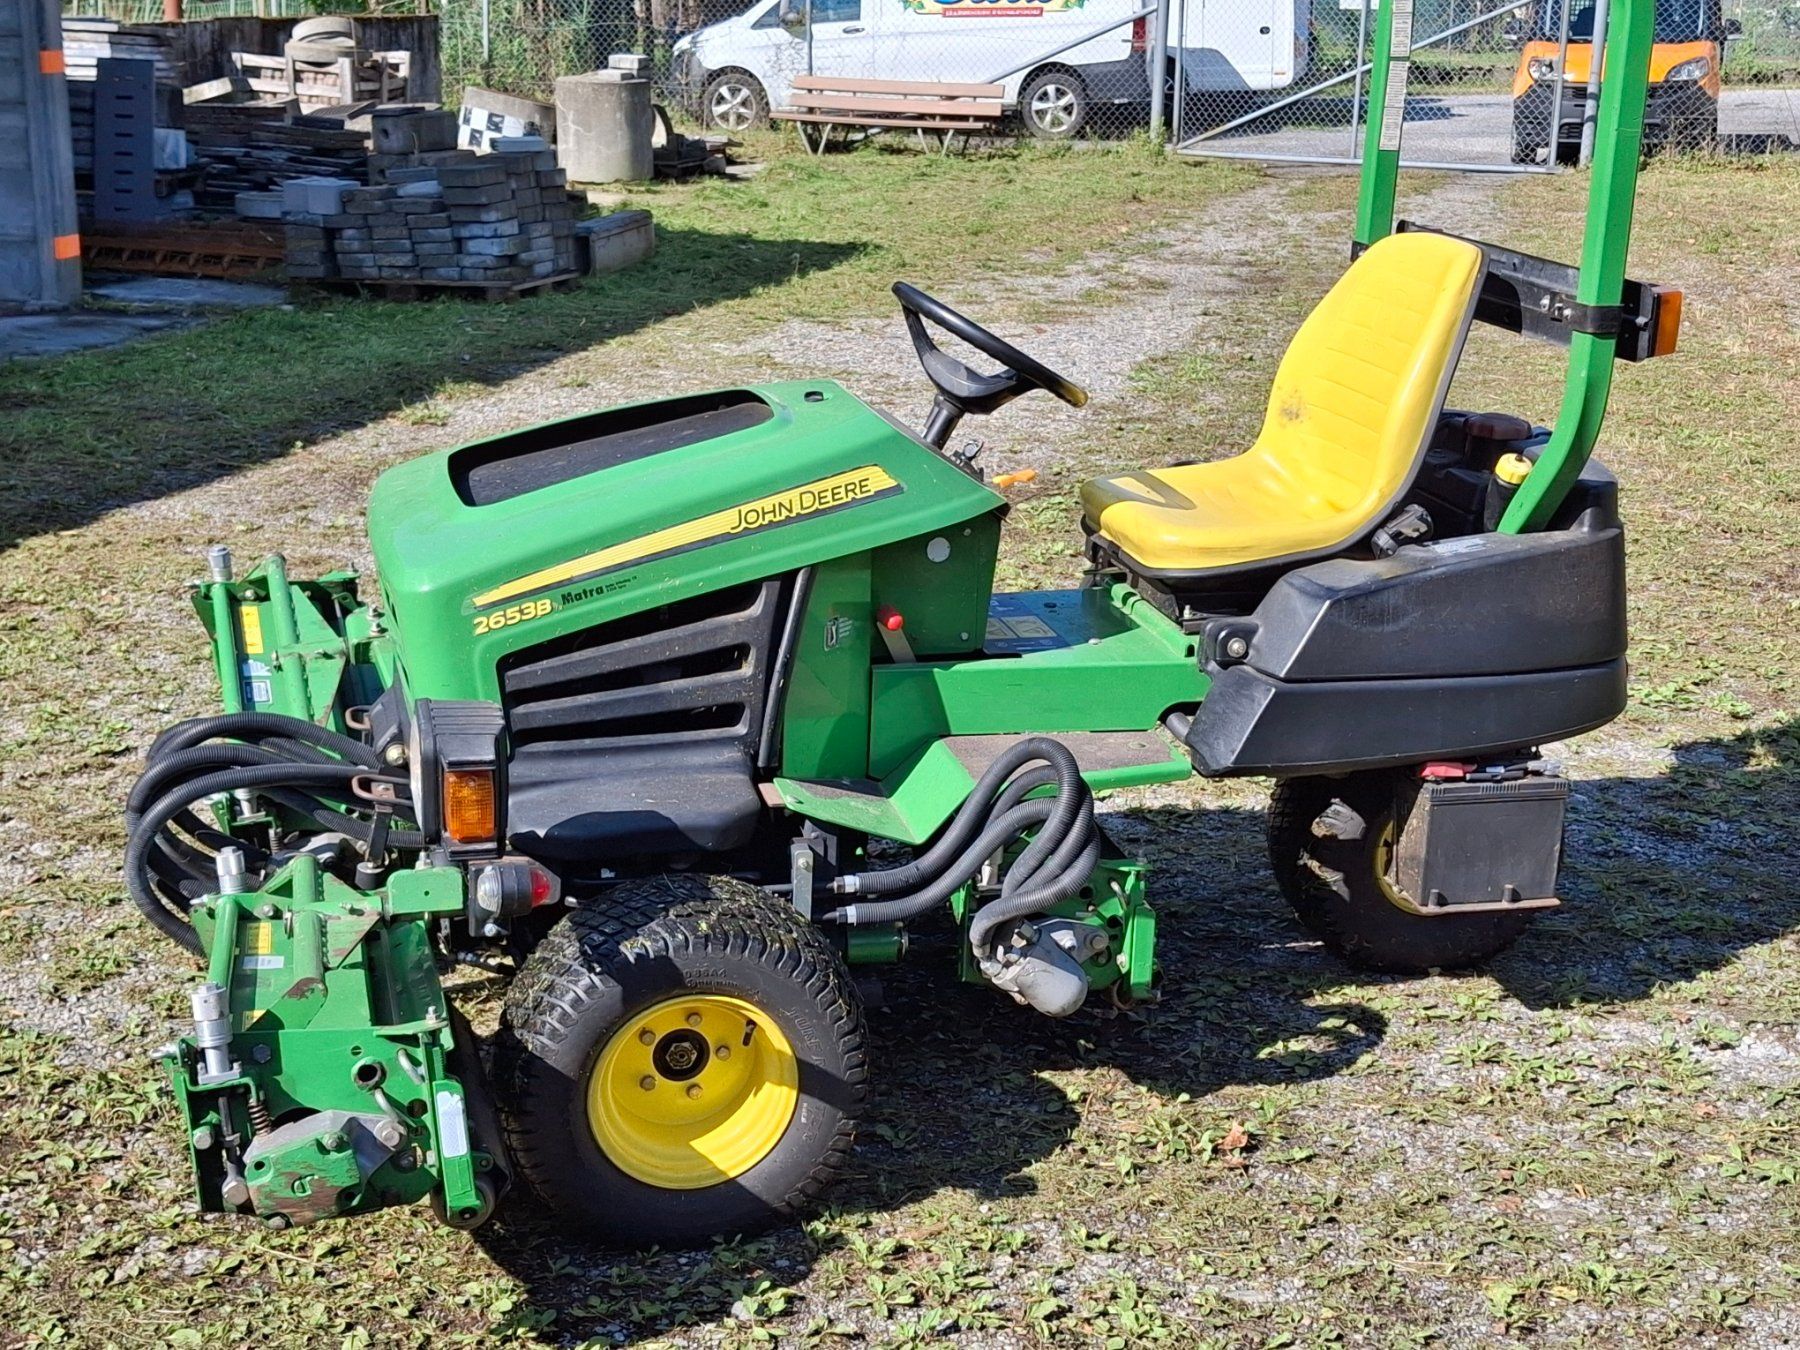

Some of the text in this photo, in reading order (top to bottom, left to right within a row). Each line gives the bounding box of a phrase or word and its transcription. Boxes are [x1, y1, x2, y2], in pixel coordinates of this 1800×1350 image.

[731, 478, 872, 530] JOHN DEERE
[561, 586, 604, 606] Matra
[473, 598, 552, 636] 2653B
